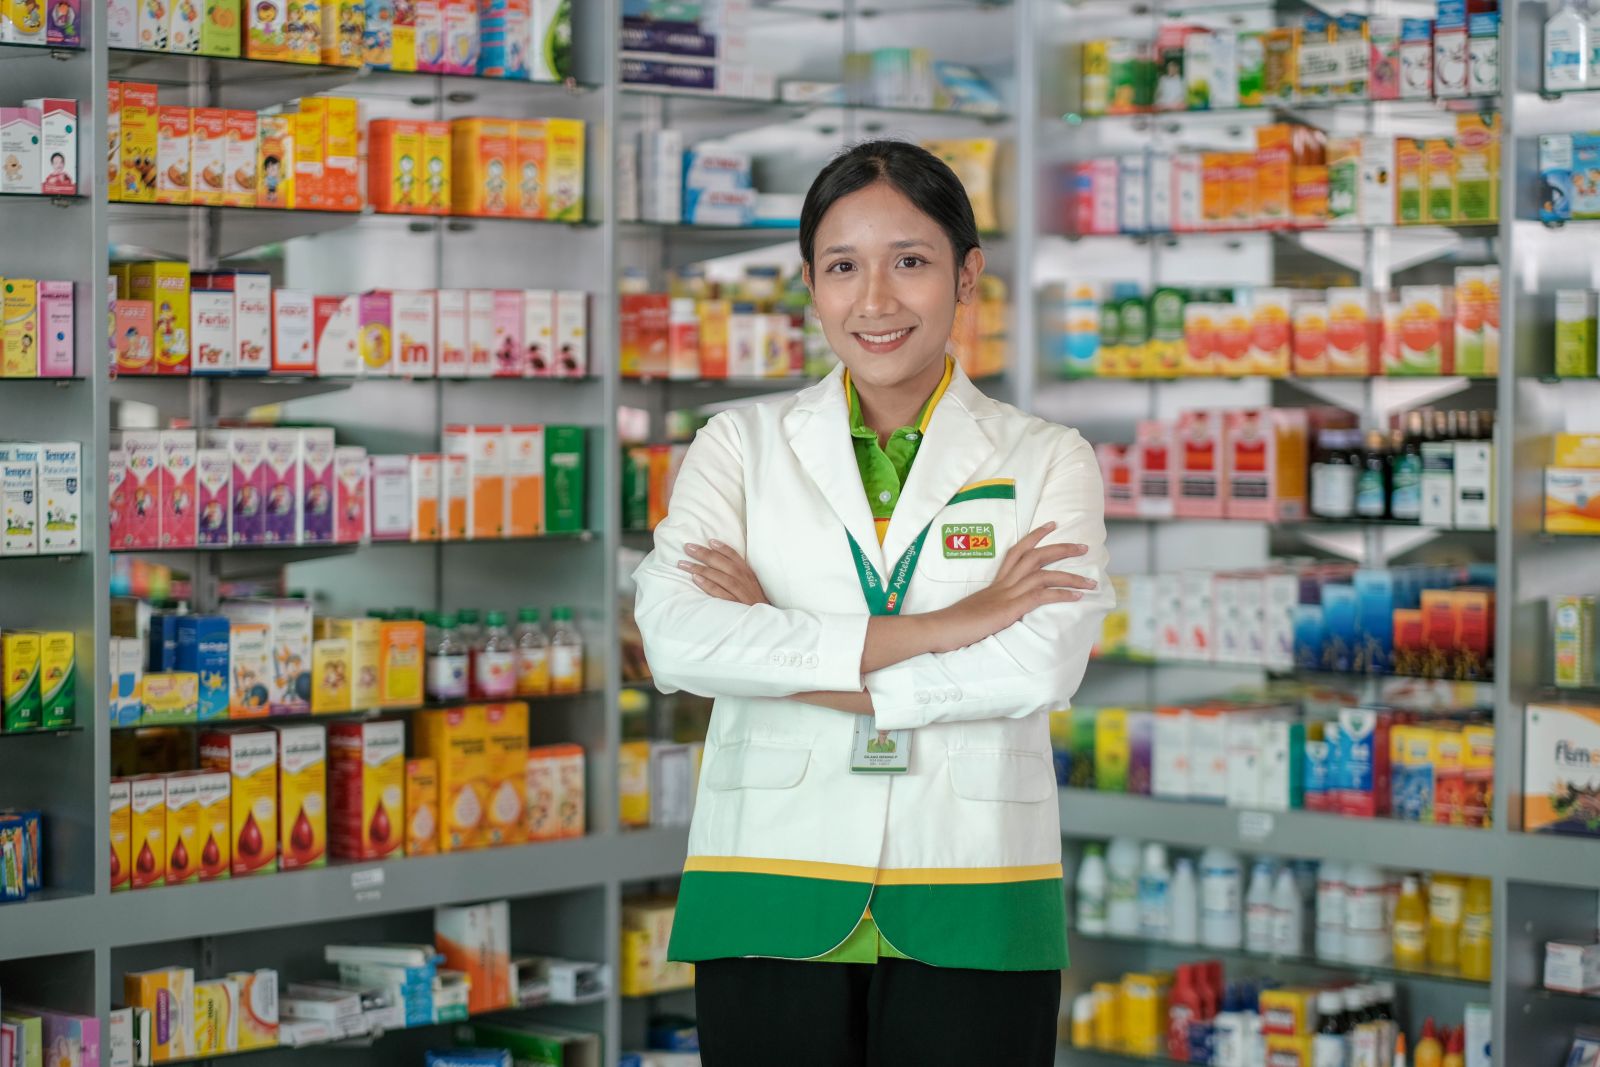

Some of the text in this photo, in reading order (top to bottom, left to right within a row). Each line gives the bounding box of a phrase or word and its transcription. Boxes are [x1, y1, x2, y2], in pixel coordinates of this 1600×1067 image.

[16, 448, 38, 462] Tempr
[45, 449, 76, 464] Tempra
[5, 466, 32, 479] Tempra
[945, 526, 991, 534] APOTEK
[953, 535, 990, 549] K 24
